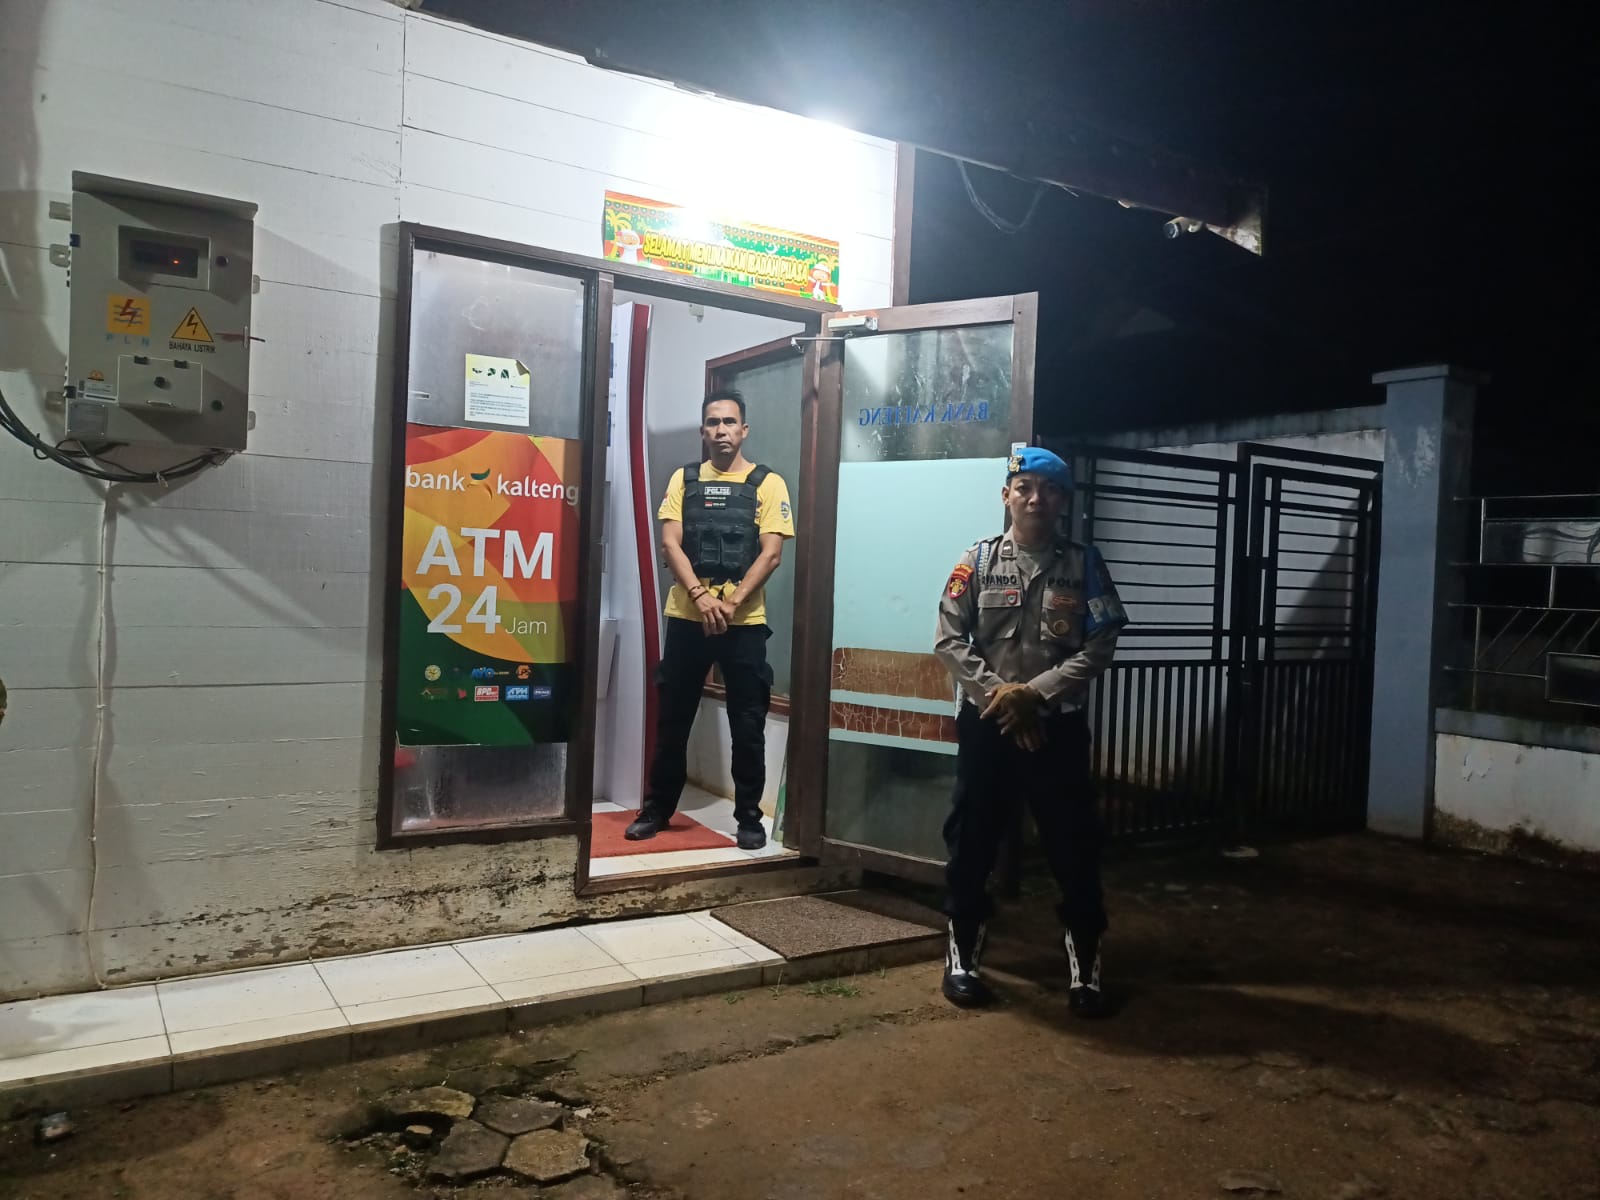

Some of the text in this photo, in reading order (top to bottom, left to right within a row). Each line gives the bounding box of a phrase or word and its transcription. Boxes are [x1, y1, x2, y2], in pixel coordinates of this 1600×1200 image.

[643, 232, 688, 260] SELAMAT
[780, 259, 808, 284] PUASA
[105, 333, 150, 347] PLN
[168, 341, 217, 354] BAHAYA LISTRIK
[405, 466, 580, 506] bank kalteng
[705, 487, 731, 495] POLISI
[416, 525, 554, 580] ATM
[427, 583, 547, 635] 24 Jam
